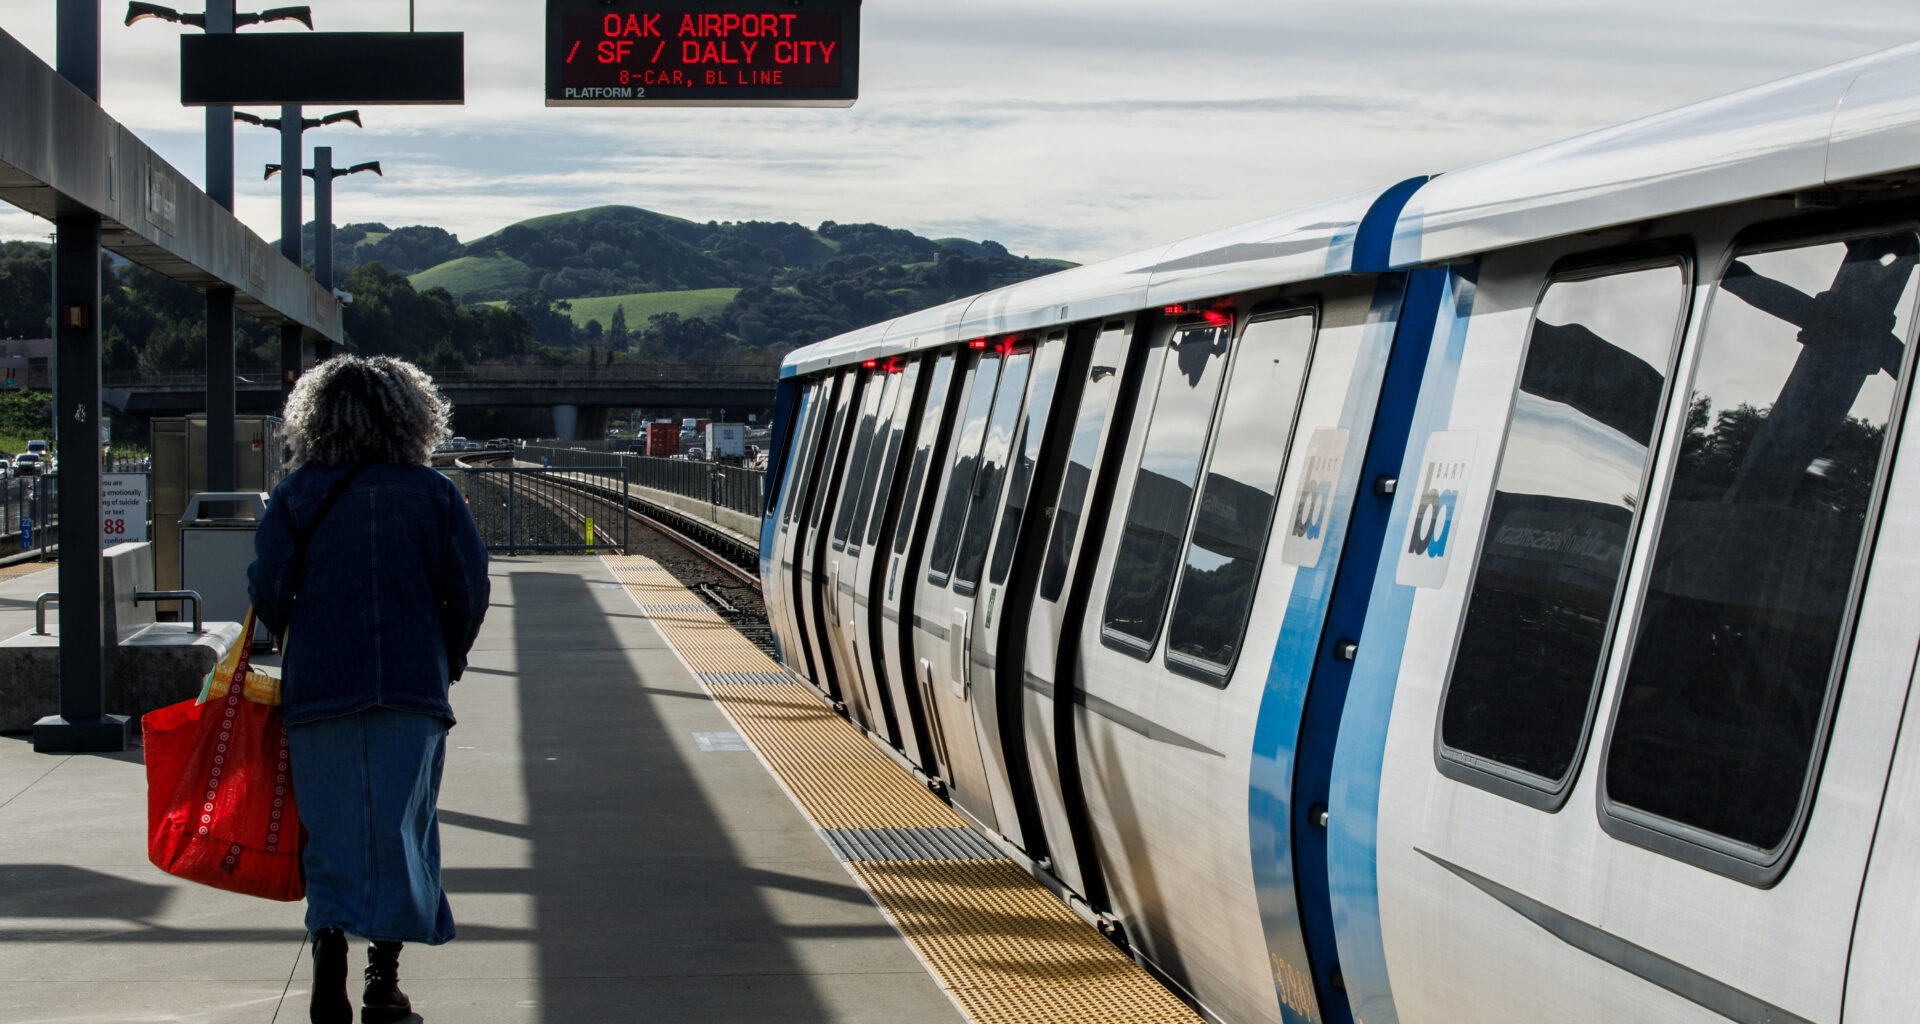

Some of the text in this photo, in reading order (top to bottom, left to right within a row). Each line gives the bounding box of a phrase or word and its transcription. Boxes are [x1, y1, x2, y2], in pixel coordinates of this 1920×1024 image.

[604, 13, 797, 38] OAK AIRPORT
[566, 40, 836, 64] / SF / DALY CITY
[619, 69, 783, 88] 8-CAR, BL LINE
[565, 87, 645, 98] PLATFORM 2
[1436, 462, 1466, 480] BART
